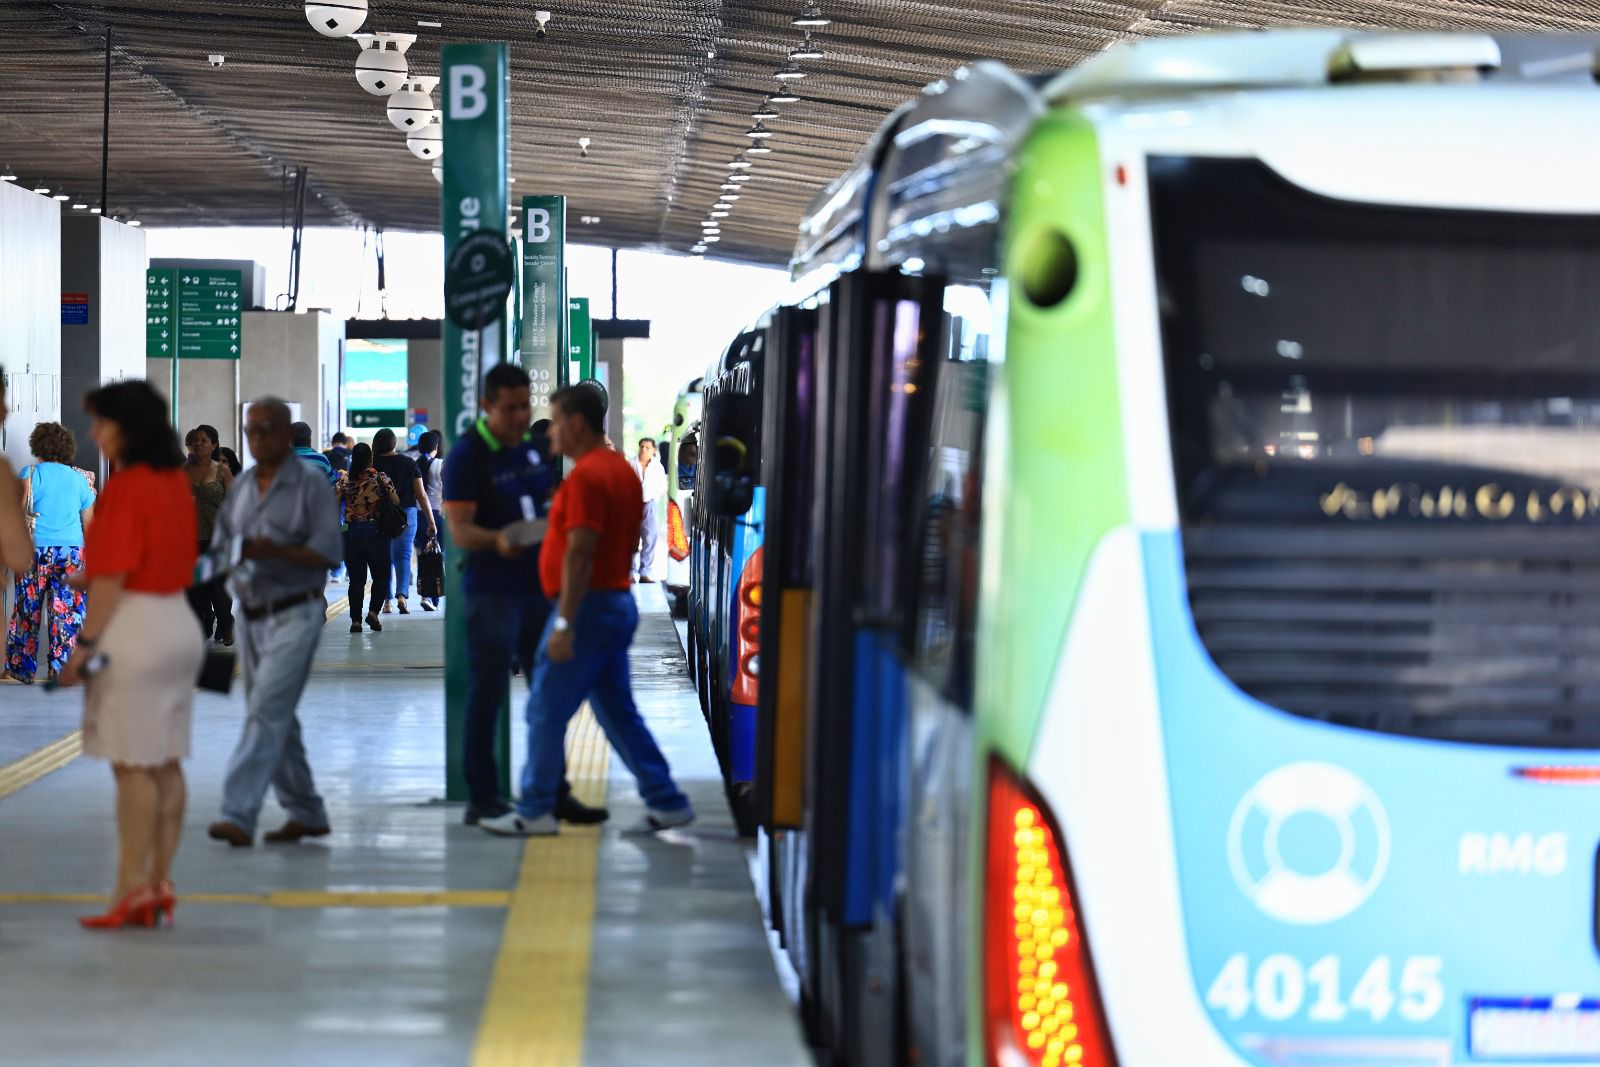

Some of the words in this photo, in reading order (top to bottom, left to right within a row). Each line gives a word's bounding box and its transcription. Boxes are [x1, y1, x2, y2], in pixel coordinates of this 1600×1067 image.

[450, 64, 487, 119] B
[528, 208, 550, 242] B
[456, 196, 480, 435] Desemue
[1459, 832, 1568, 875] RMG
[1206, 952, 1445, 1022] 40145
